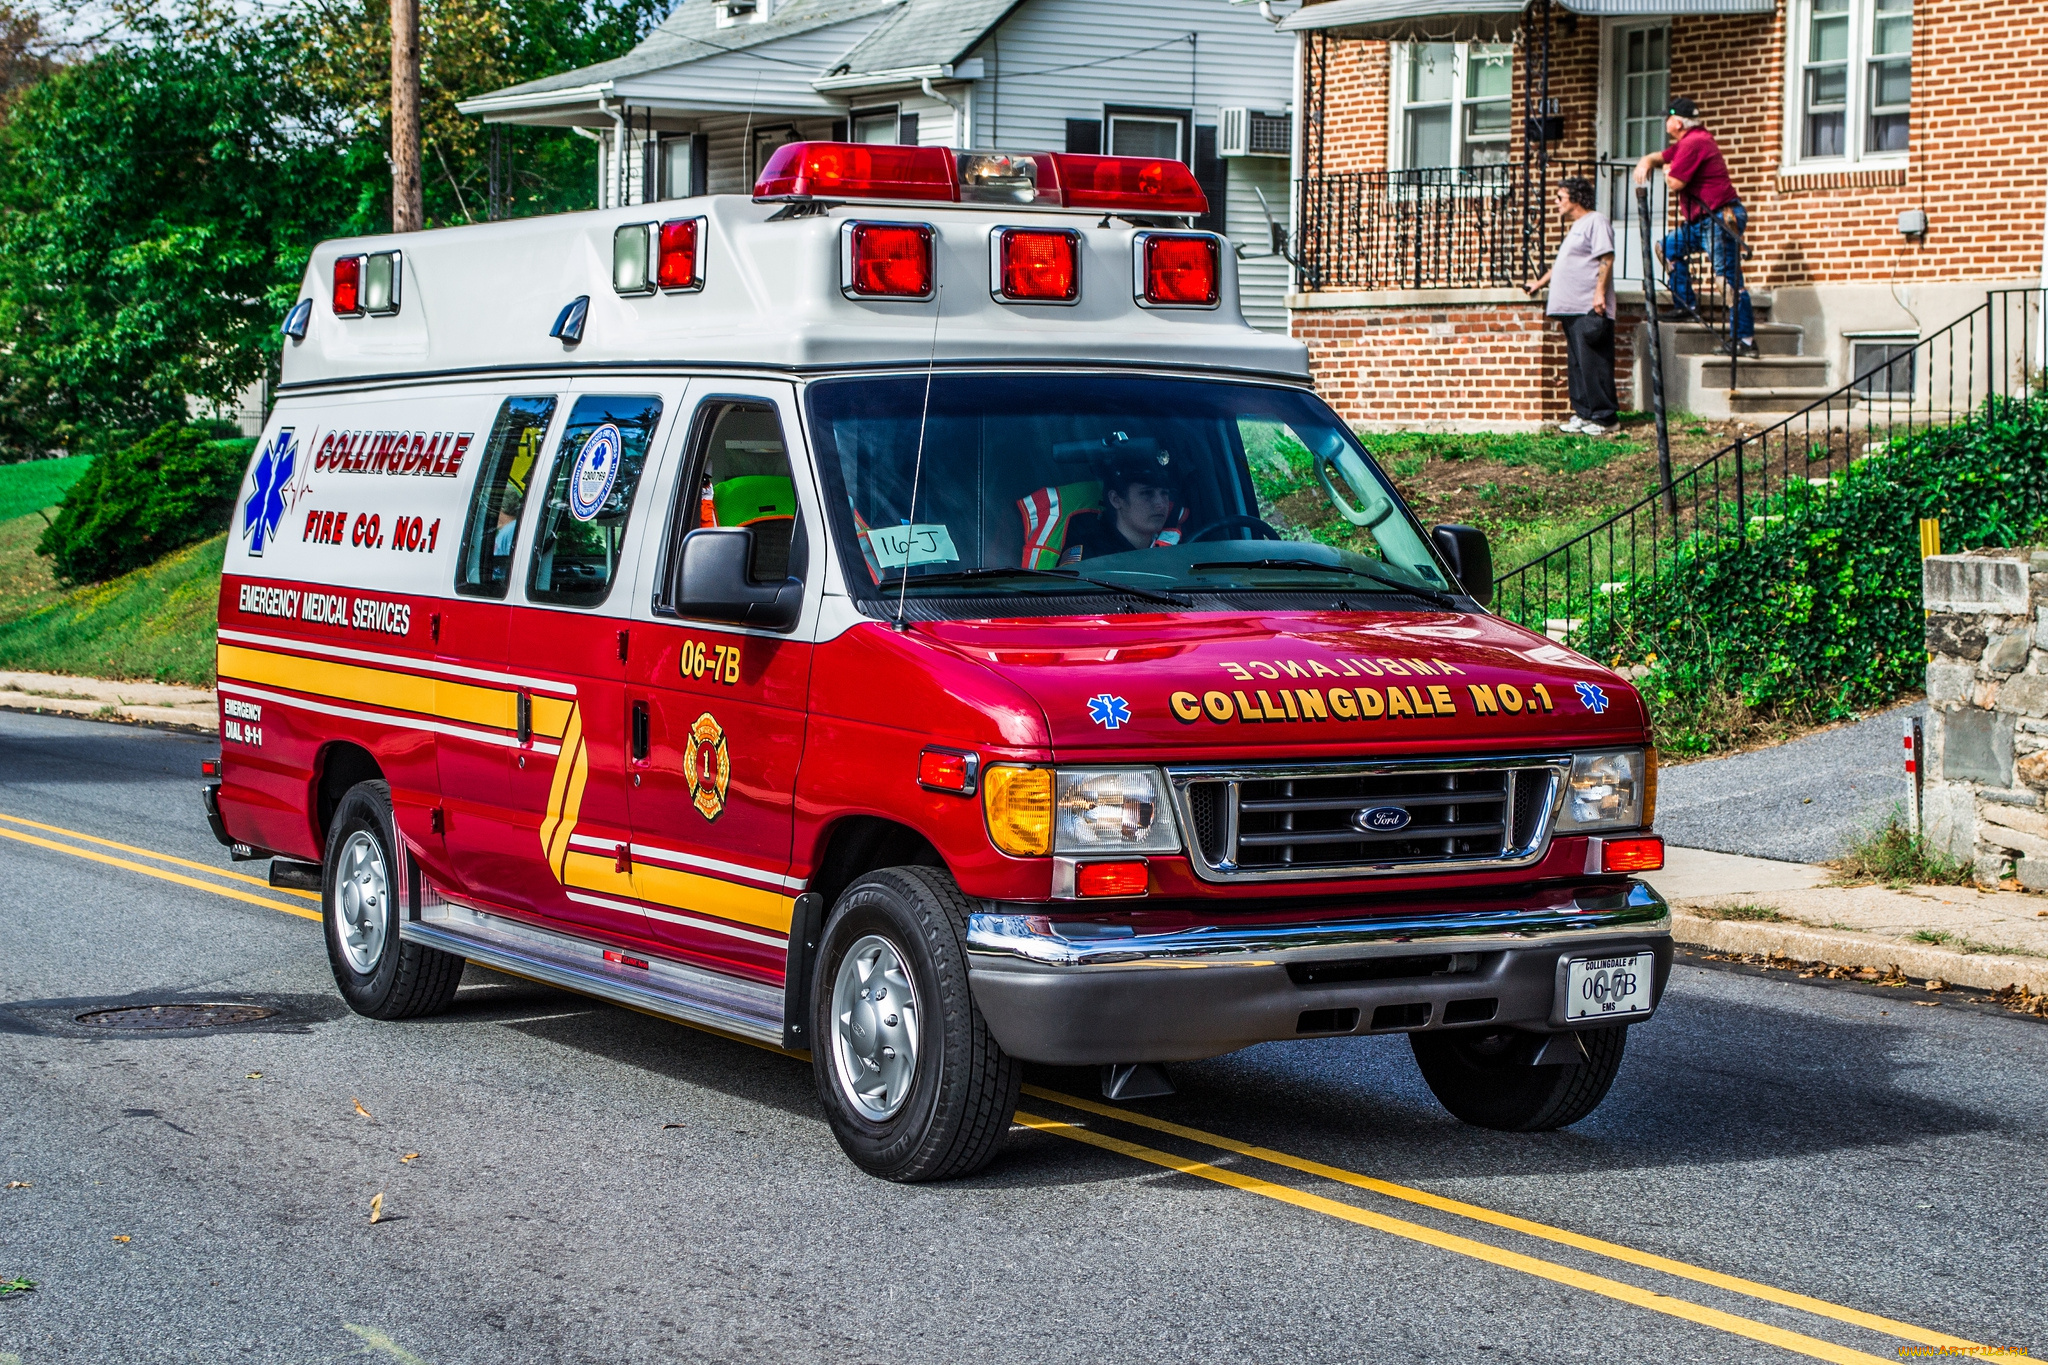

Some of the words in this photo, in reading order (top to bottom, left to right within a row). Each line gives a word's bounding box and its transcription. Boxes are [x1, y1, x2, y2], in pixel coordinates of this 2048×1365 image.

[314, 430, 475, 478] COLLINGDALE
[303, 510, 348, 545] FIRE
[353, 513, 384, 549] CO.
[391, 516, 441, 553] NO.1
[881, 531, 939, 556] 16-J
[239, 584, 301, 620] EMERGENCY
[302, 592, 349, 627] MEDICAL
[352, 598, 411, 637] SERVICES
[680, 639, 741, 686] 06-7B
[225, 698, 262, 722] EMERGENCY
[1169, 684, 1457, 723] COLLINGDALE
[1467, 682, 1554, 716] NO.1
[225, 720, 243, 743] DIAL
[244, 724, 262, 748] 9-1-1
[703, 749, 710, 779] 1
[1373, 811, 1400, 826] Ford
[1585, 958, 1627, 971] COLLINGDALE
[1628, 957, 1638, 966] #1
[1582, 973, 1637, 1000] 06-7B
[1602, 1002, 1616, 1012] EMS
